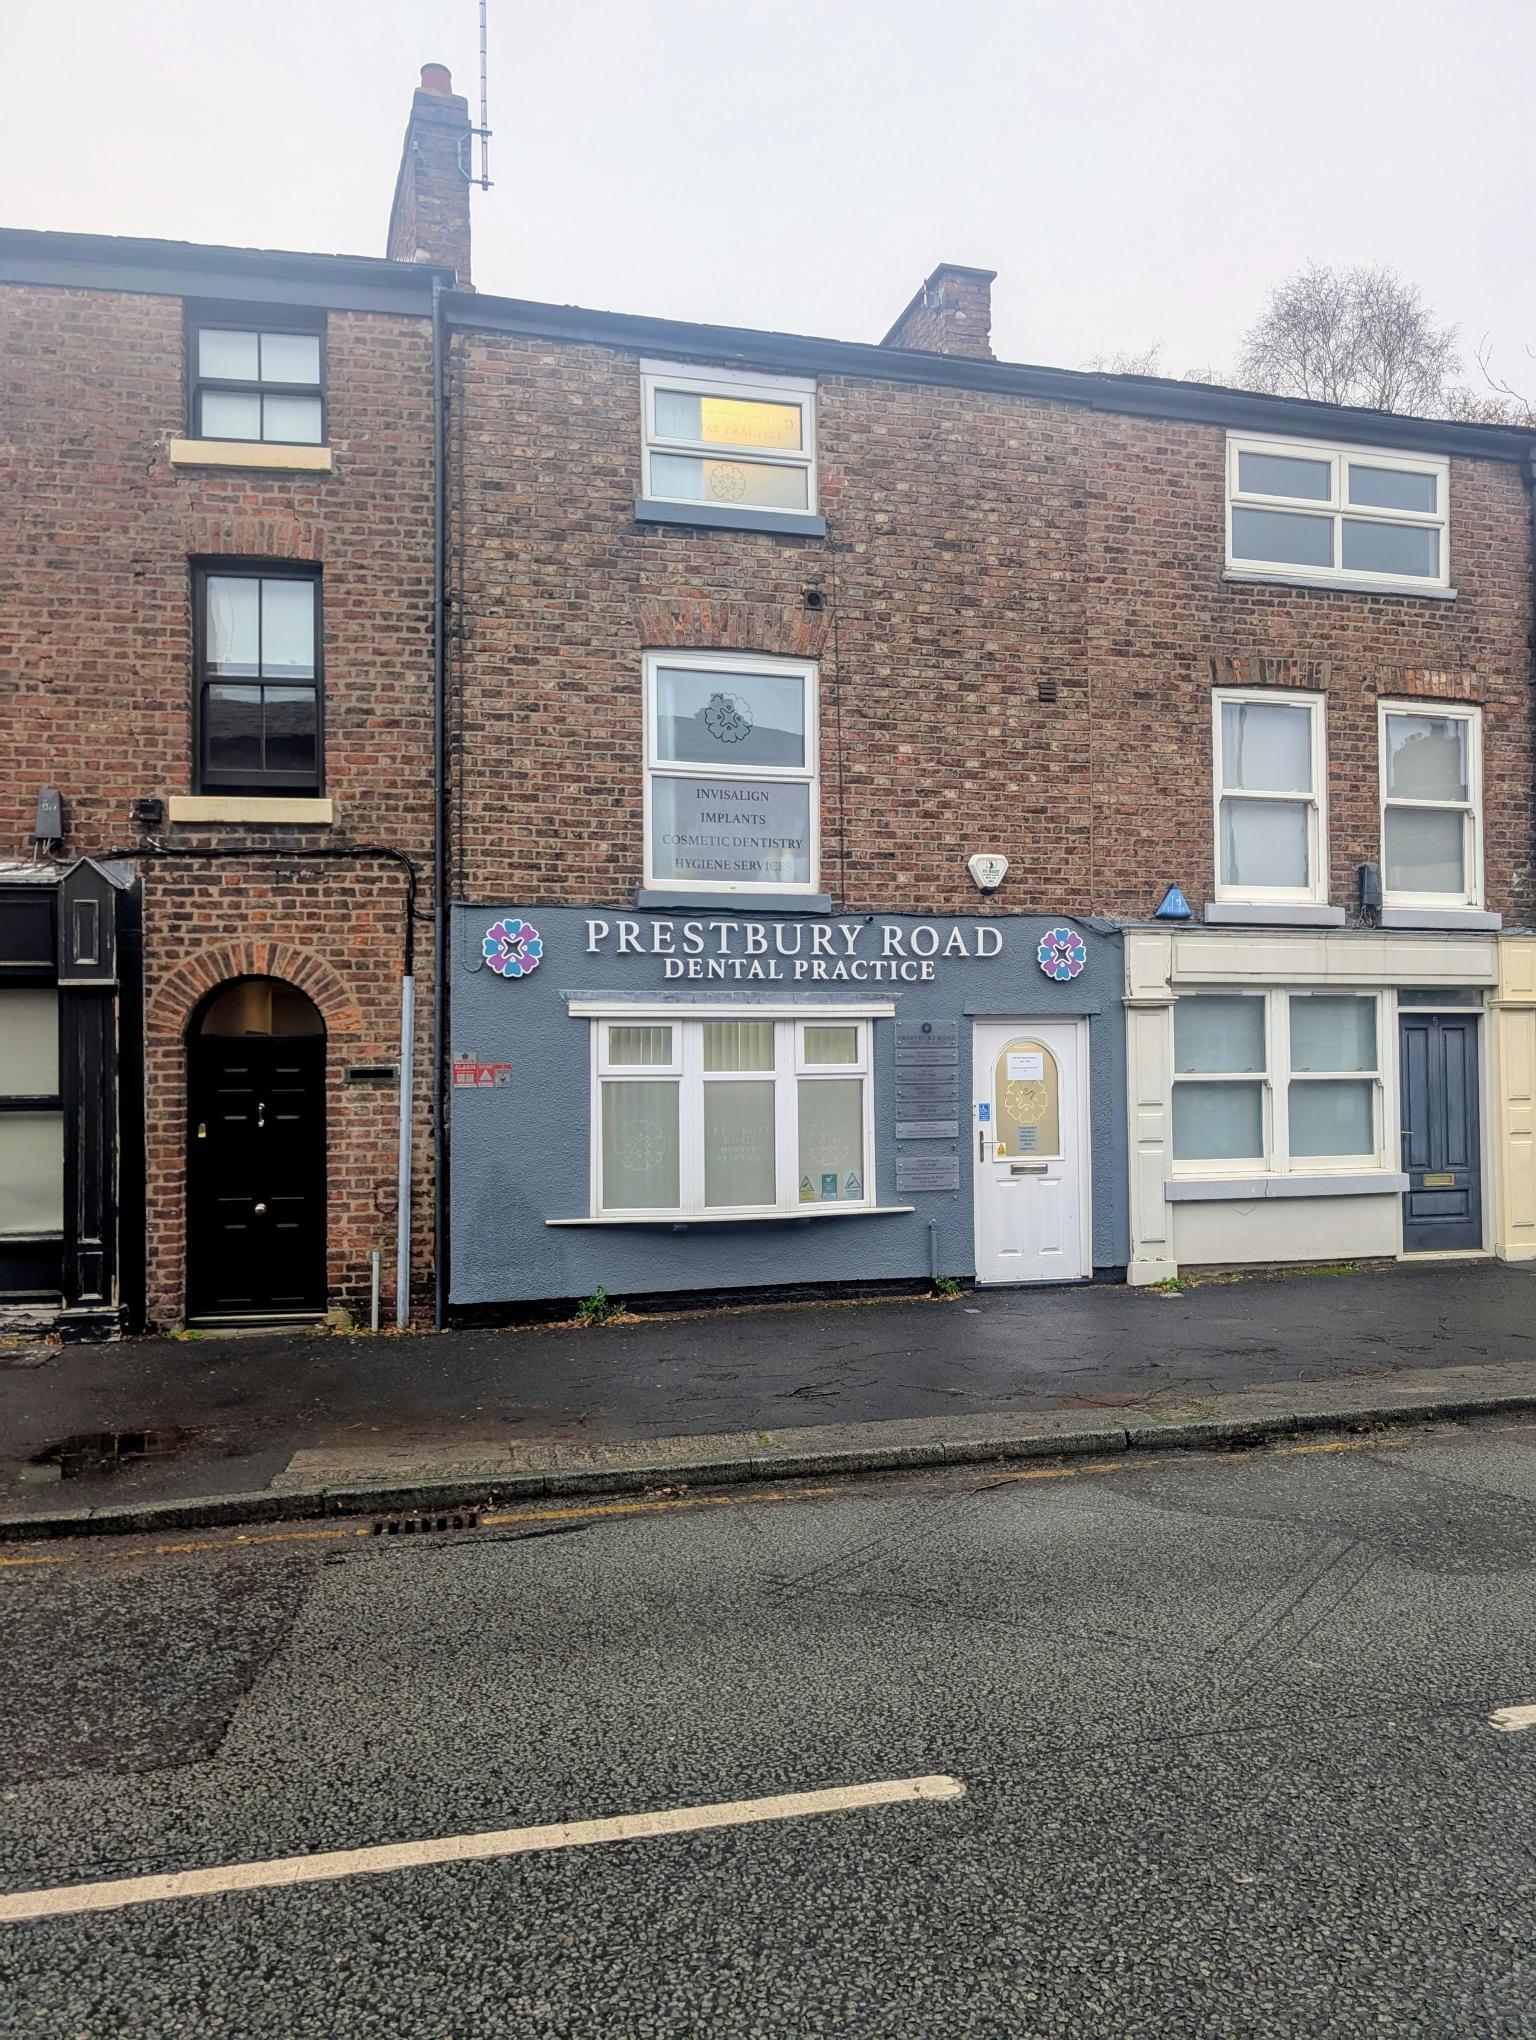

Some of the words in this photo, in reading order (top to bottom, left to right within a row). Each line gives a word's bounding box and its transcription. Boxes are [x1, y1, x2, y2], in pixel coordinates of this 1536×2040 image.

[696, 788, 769, 802] INVISALIGN
[701, 812, 766, 825] IMPLANTS
[662, 834, 730, 847] COSMETIC
[733, 837, 804, 849] DENTISTRY
[675, 858, 730, 870] HYGIENE
[734, 860, 793, 872] SERVICES
[585, 920, 864, 955] PRESTBURY
[881, 925, 1003, 957] ROAD
[664, 958, 784, 979] DENTAL
[793, 959, 936, 981] PRACTICE
